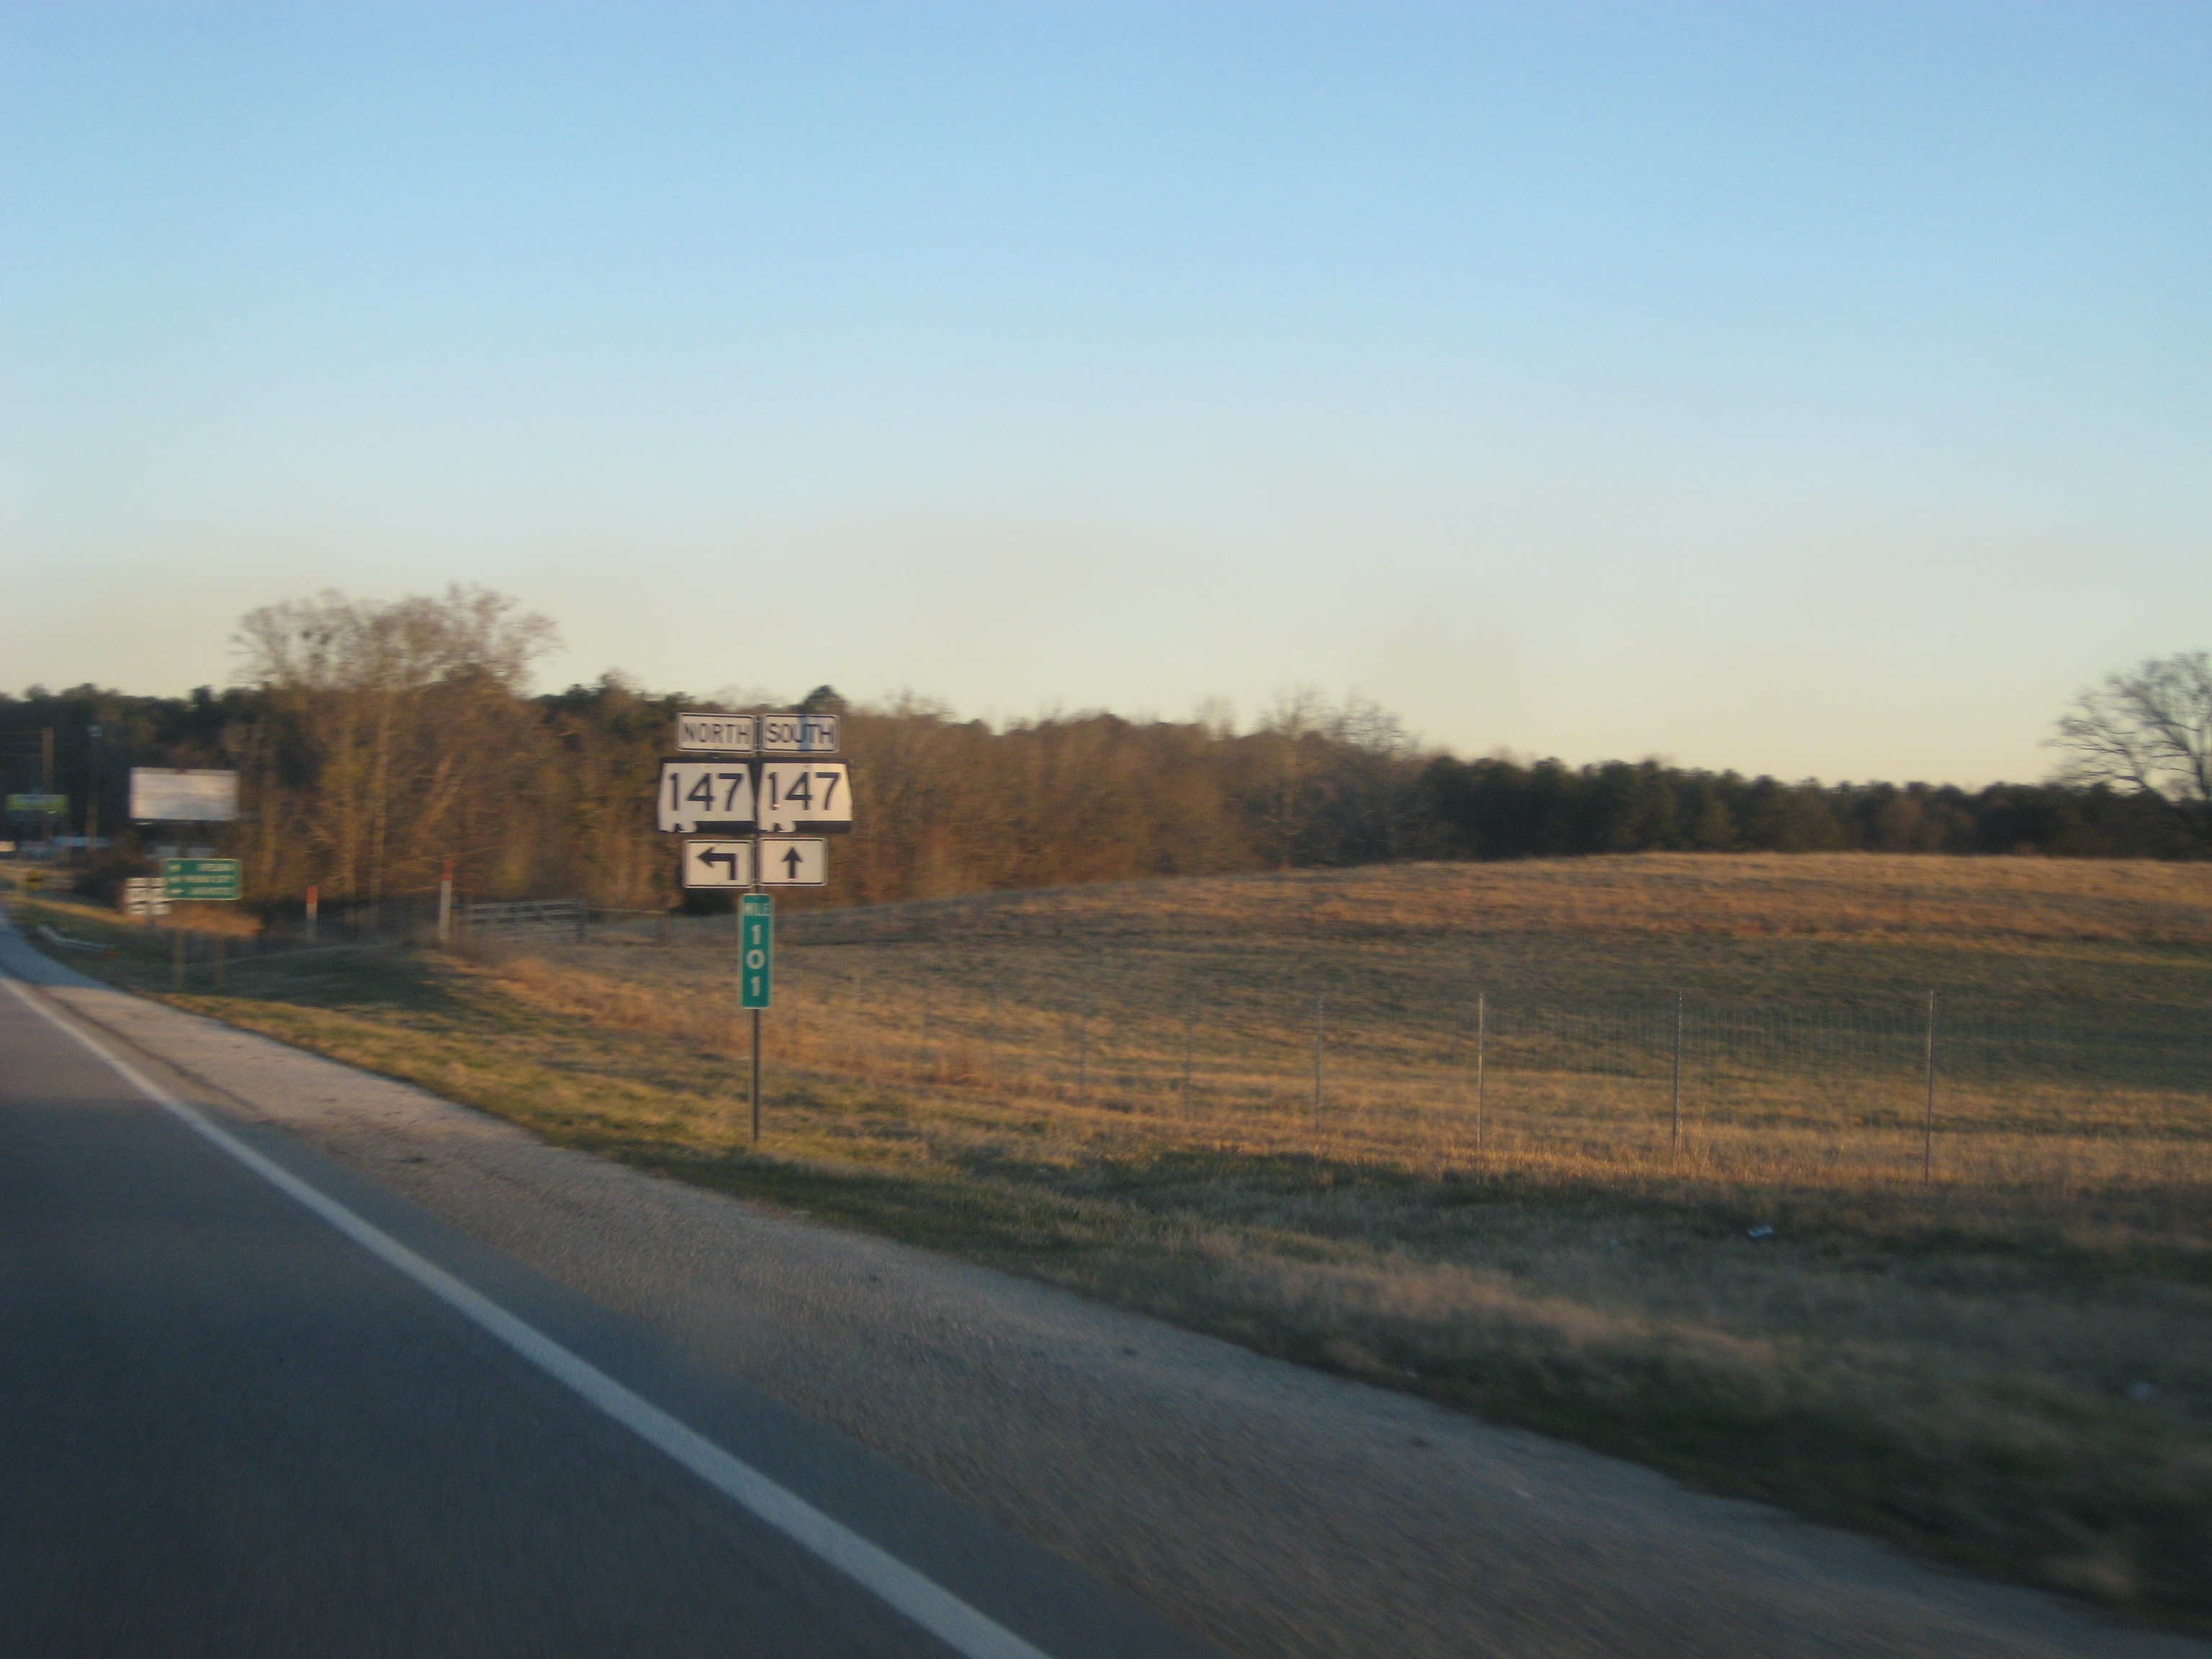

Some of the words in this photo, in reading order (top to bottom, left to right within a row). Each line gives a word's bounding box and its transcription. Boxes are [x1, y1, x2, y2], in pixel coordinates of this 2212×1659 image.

[680, 723, 748, 744] NORTH
[766, 722, 835, 744] SOUTH
[669, 773, 744, 811] 147
[767, 772, 840, 811] 147
[742, 902, 771, 917] MILE
